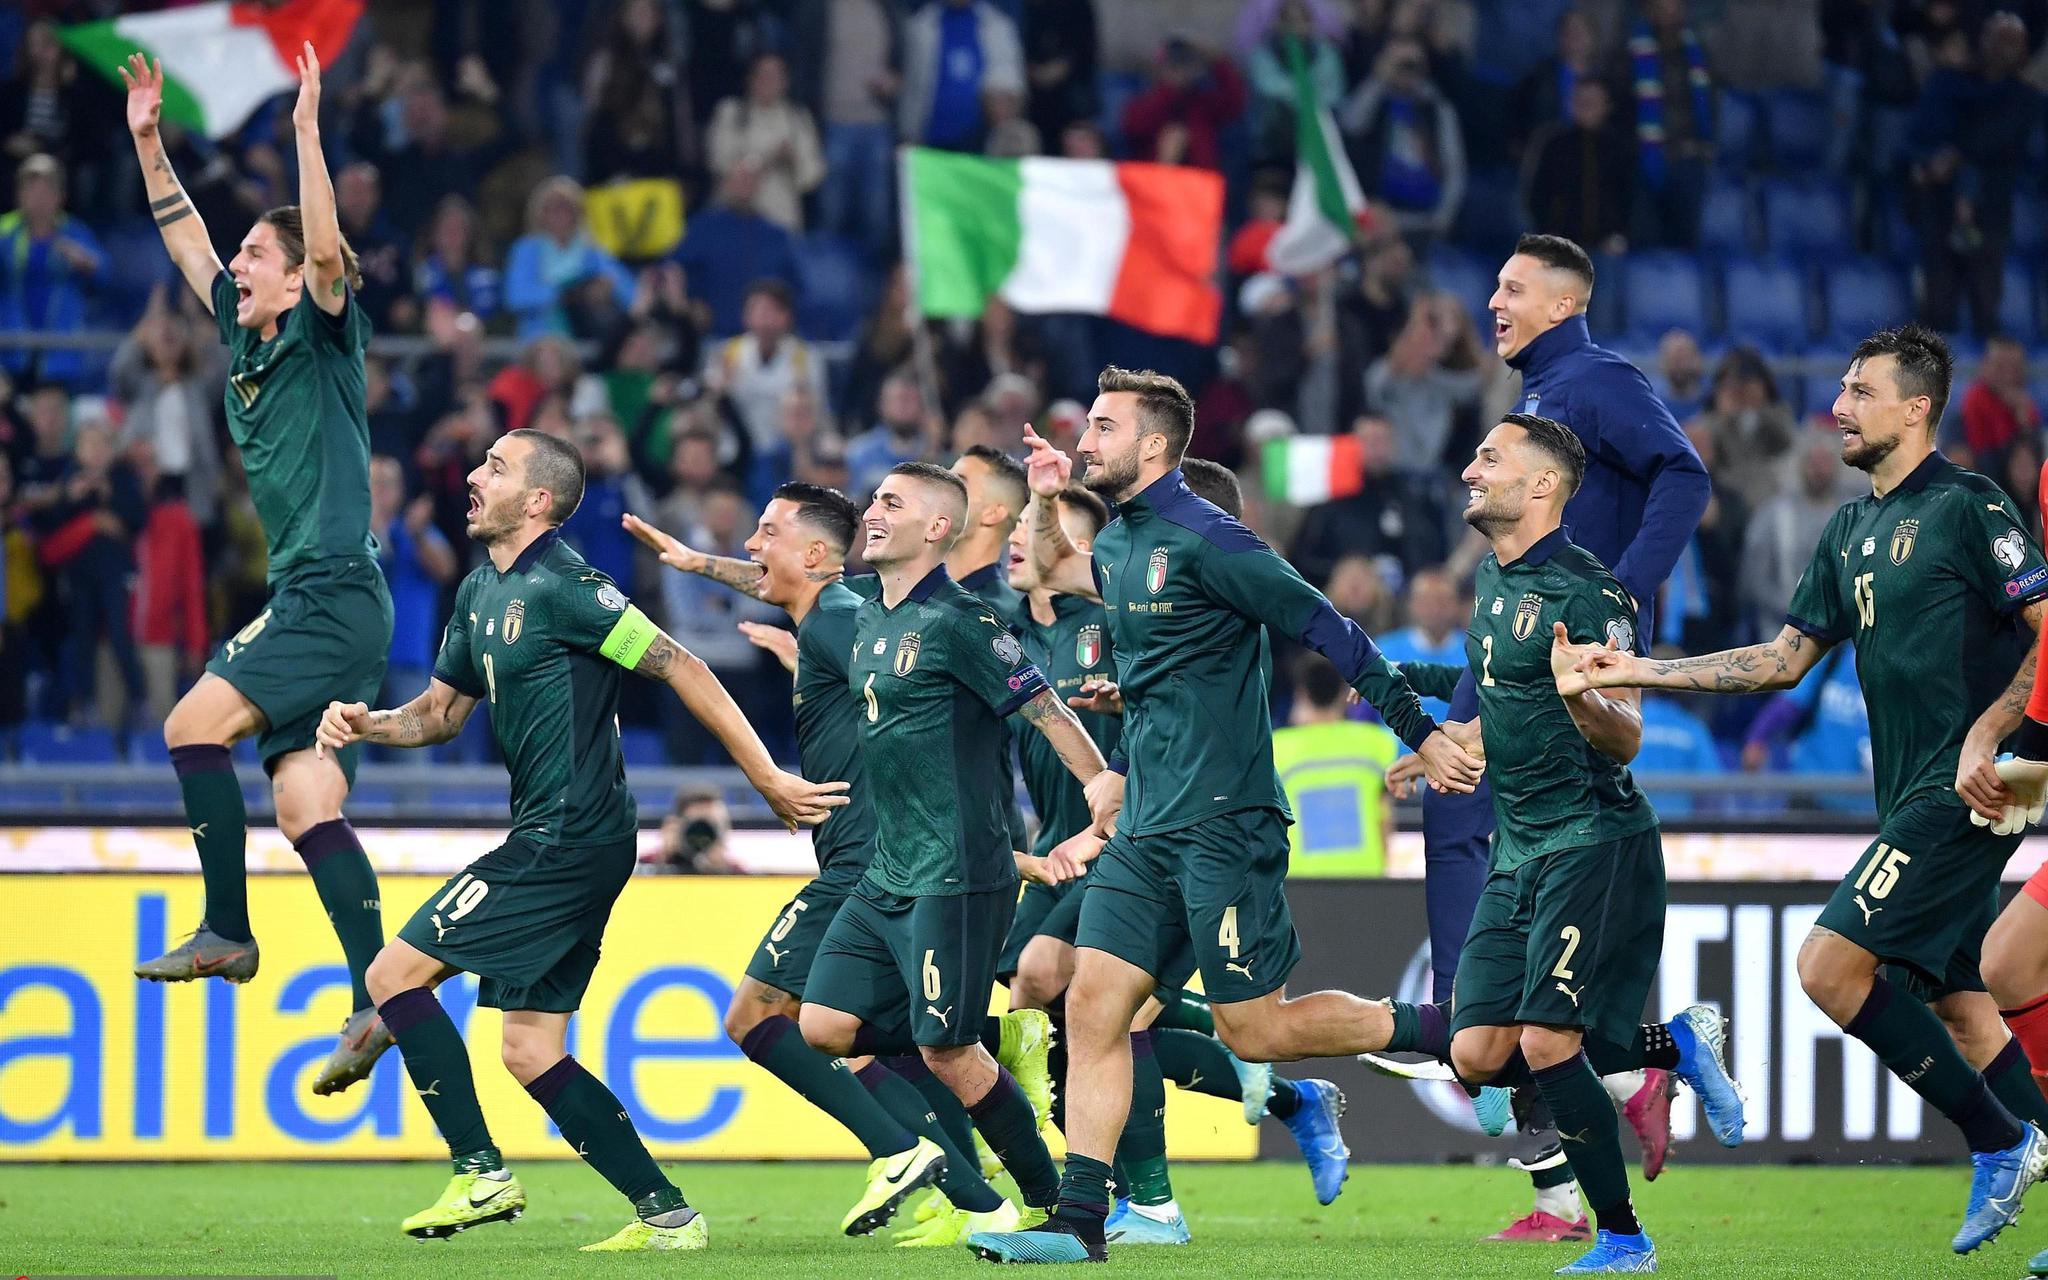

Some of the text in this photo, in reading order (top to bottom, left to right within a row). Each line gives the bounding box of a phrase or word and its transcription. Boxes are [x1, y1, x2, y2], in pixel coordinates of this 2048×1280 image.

[1854, 572, 1876, 630] 15
[2019, 568, 2048, 589] RESPECT
[615, 628, 641, 661] RESPECT
[1481, 635, 1496, 687] 2
[863, 672, 879, 723] 6
[435, 873, 489, 921] 19
[1854, 842, 1911, 900] 15
[770, 899, 809, 942] 5
[1218, 906, 1241, 958] 4
[922, 949, 941, 1001] 6
[1551, 925, 1581, 980] 2
[1658, 903, 1923, 1142] FIA
